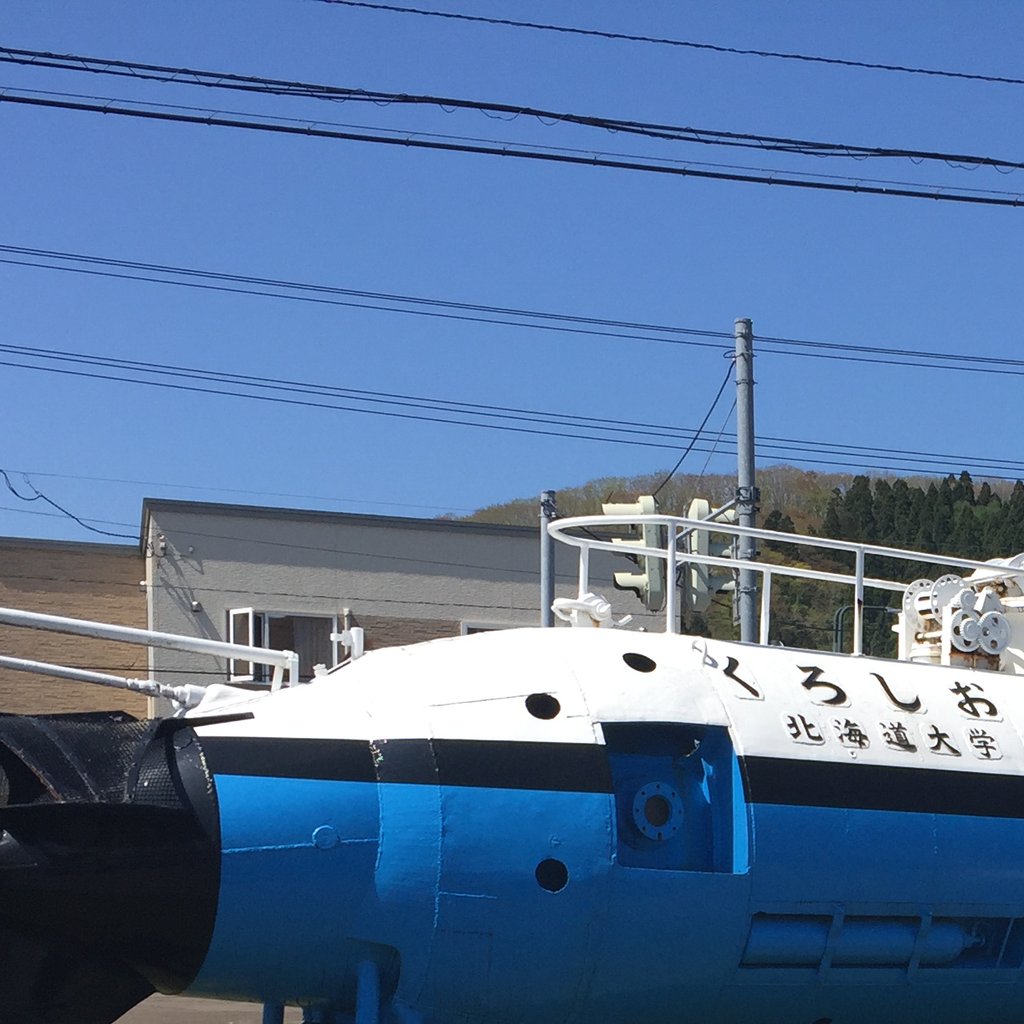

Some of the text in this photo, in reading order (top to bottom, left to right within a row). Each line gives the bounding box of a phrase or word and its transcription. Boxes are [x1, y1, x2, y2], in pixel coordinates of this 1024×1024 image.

[723, 656, 998, 718] くろしお
[787, 713, 998, 759] 北海道大学
